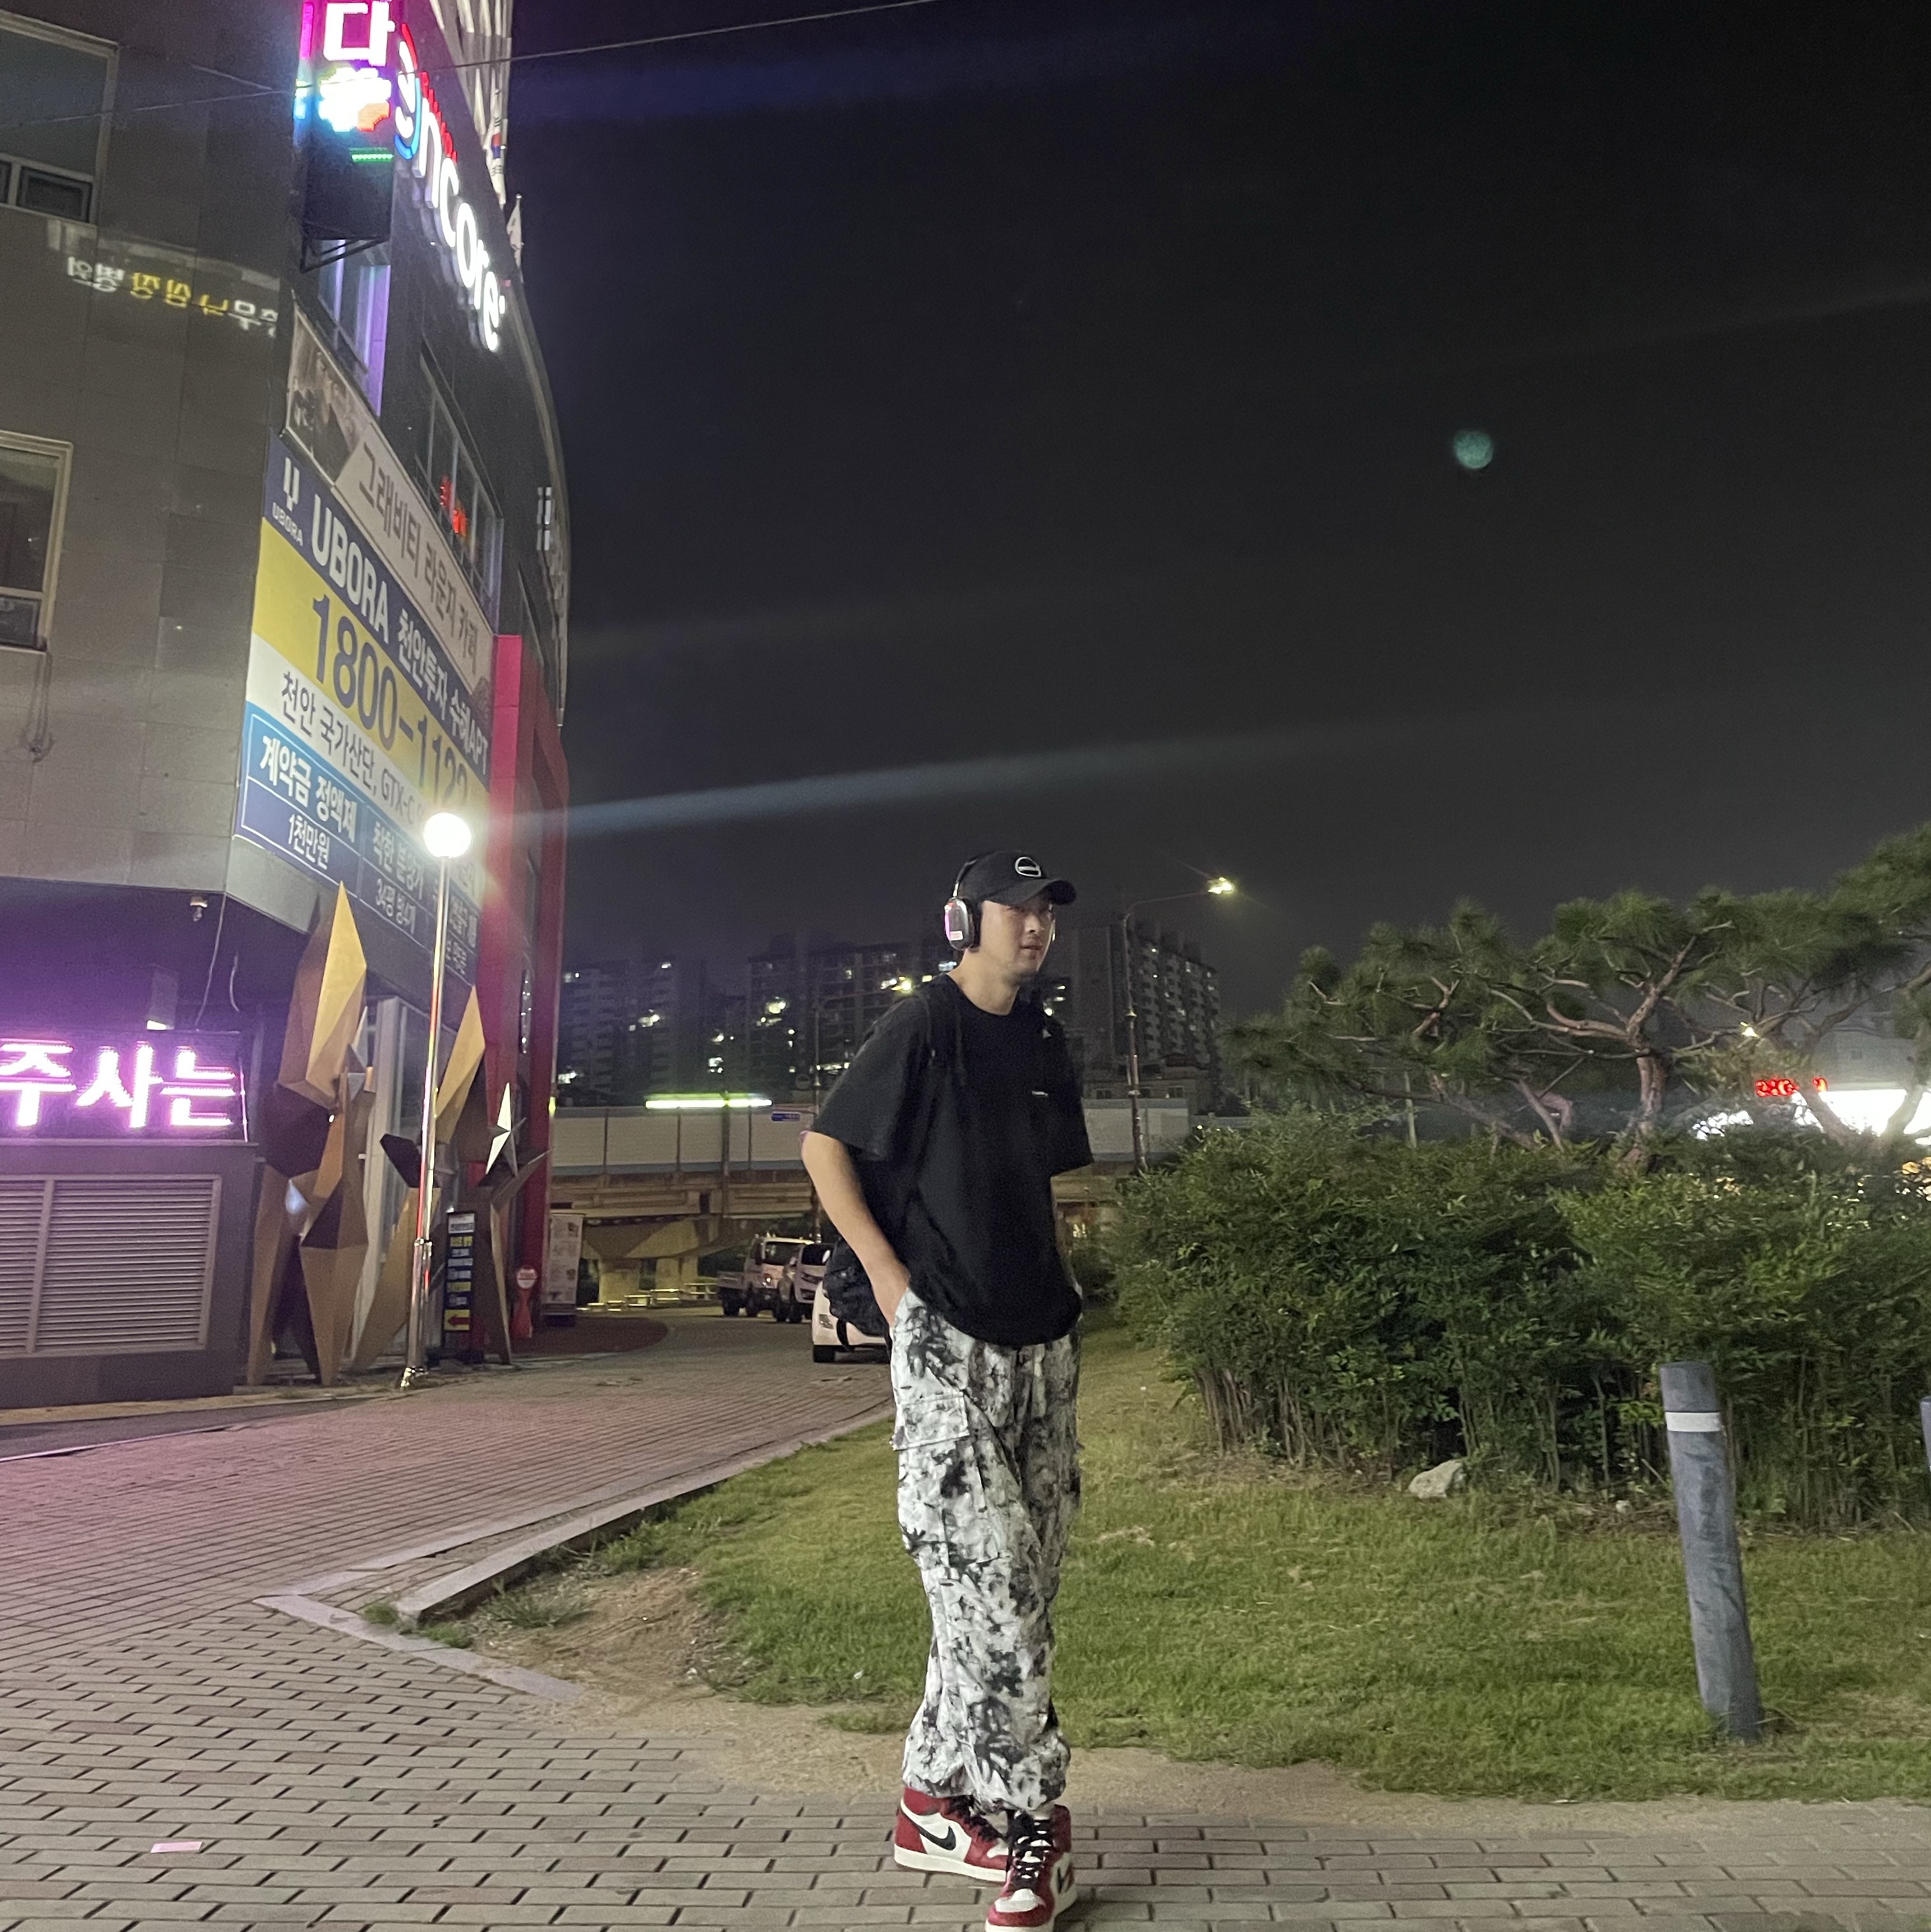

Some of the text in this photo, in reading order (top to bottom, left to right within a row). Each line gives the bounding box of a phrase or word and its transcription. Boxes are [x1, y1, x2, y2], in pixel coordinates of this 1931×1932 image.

[359, 441, 422, 579] 그래비티
[424, 540, 457, 638] 라운지
[311, 493, 389, 645] UBORA
[398, 608, 448, 721] 천안투자
[281, 671, 316, 738] 천안
[259, 735, 312, 808] 계약금
[315, 776, 358, 844] 정액제
[288, 813, 330, 870] 1천만원
